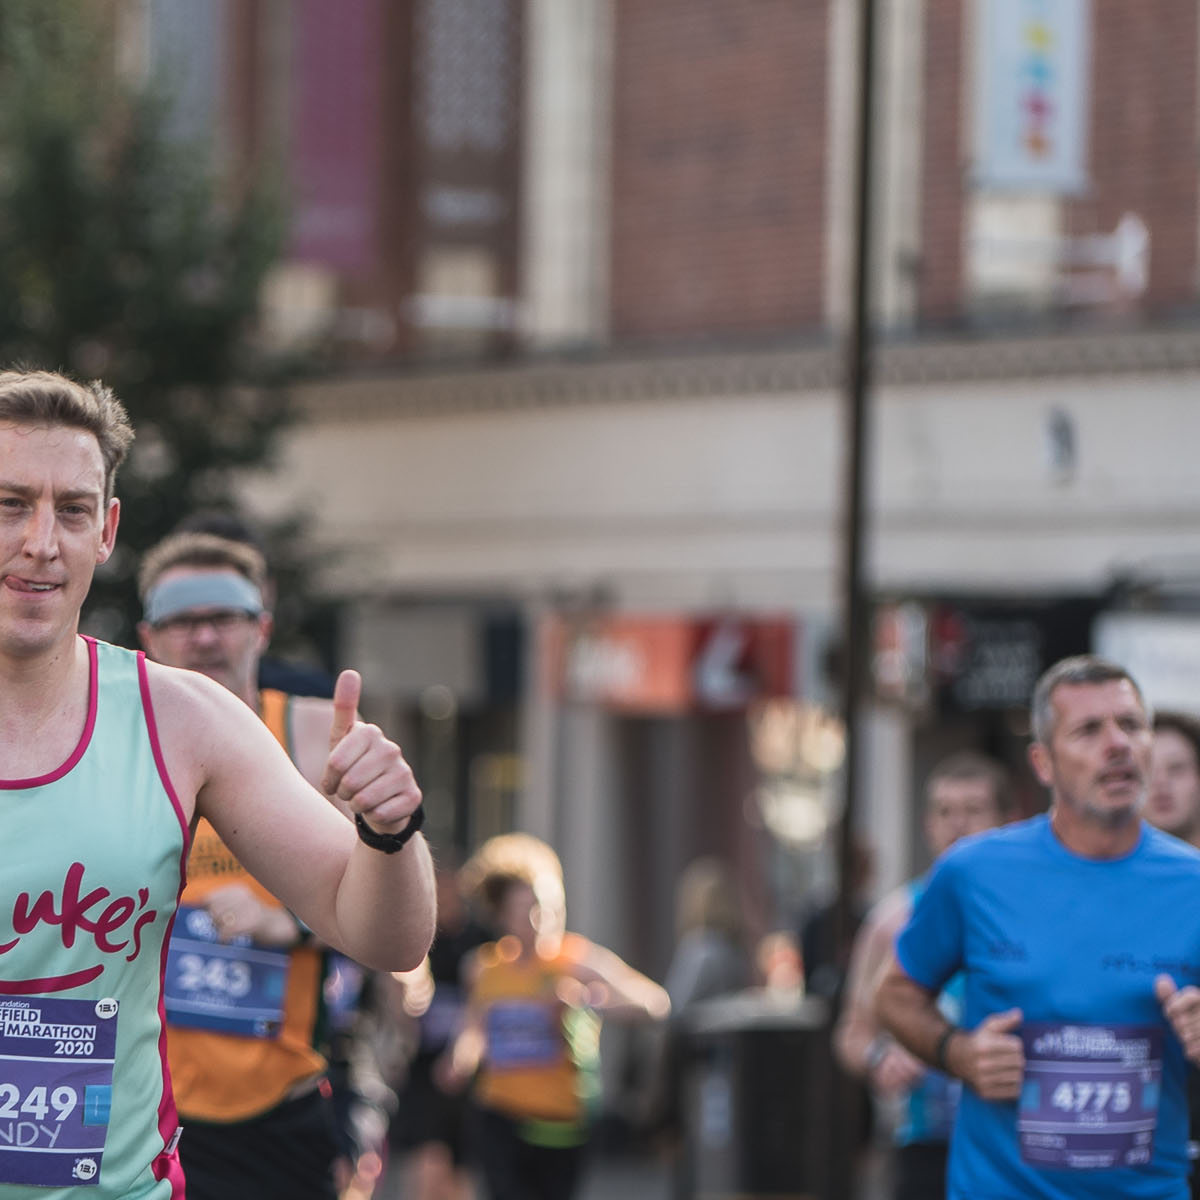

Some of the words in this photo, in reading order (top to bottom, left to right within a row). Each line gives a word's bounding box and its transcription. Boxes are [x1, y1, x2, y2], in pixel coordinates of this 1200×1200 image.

[178, 954, 250, 997] 243
[6, 1023, 95, 1040] MARATHON
[54, 1041, 94, 1056] 2020
